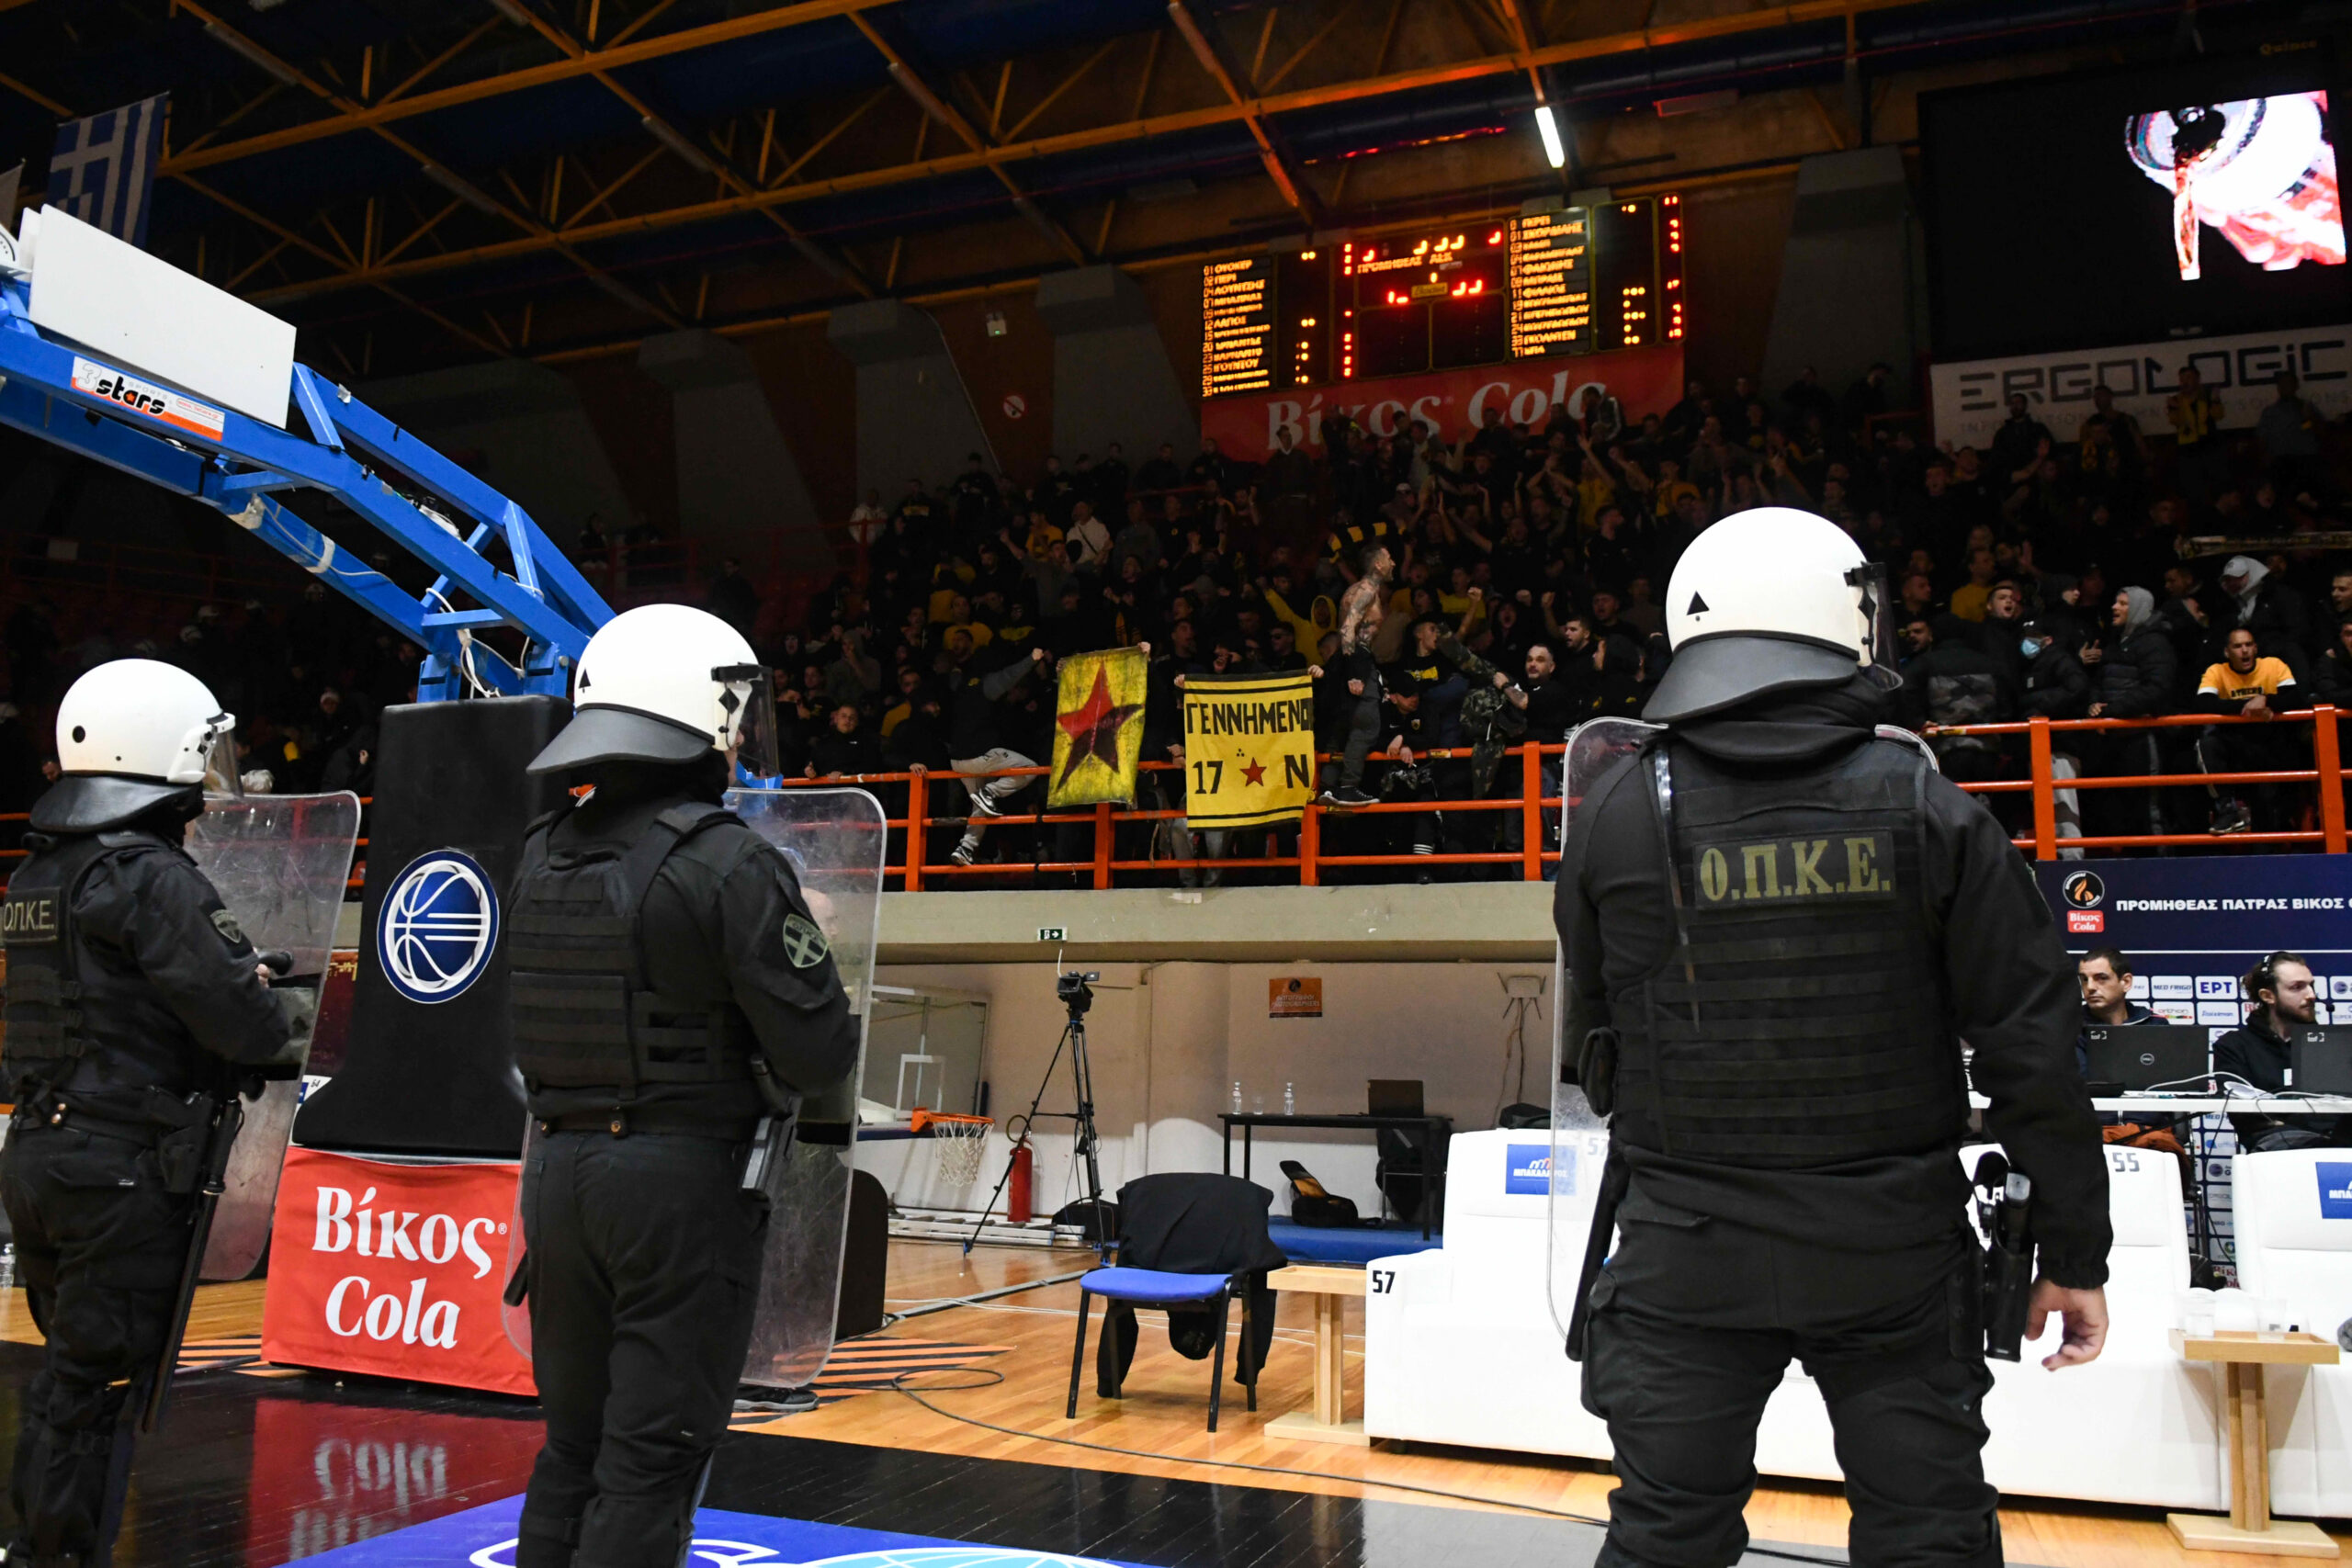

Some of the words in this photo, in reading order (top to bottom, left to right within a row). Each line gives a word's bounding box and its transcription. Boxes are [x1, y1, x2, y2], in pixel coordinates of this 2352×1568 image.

[1193, 761, 1223, 794] 17
[1284, 754, 1309, 789] Ν
[1701, 837, 1891, 901] Ο.Π.Κ.Ε.
[2116, 899, 2218, 911] ΠΡΟΜΗΘΕΑΣ
[2222, 898, 2289, 910] ΠΑΤΡΑΣ
[2291, 897, 2345, 909] ΒΙΚΟΣ
[2073, 922, 2097, 931] Cola
[2200, 982, 2233, 994] ΕΡΤ
[2112, 1152, 2140, 1172] 55
[311, 1186, 495, 1280] Βίκος
[1373, 1269, 1396, 1294] 57
[325, 1276, 460, 1349] Cola
